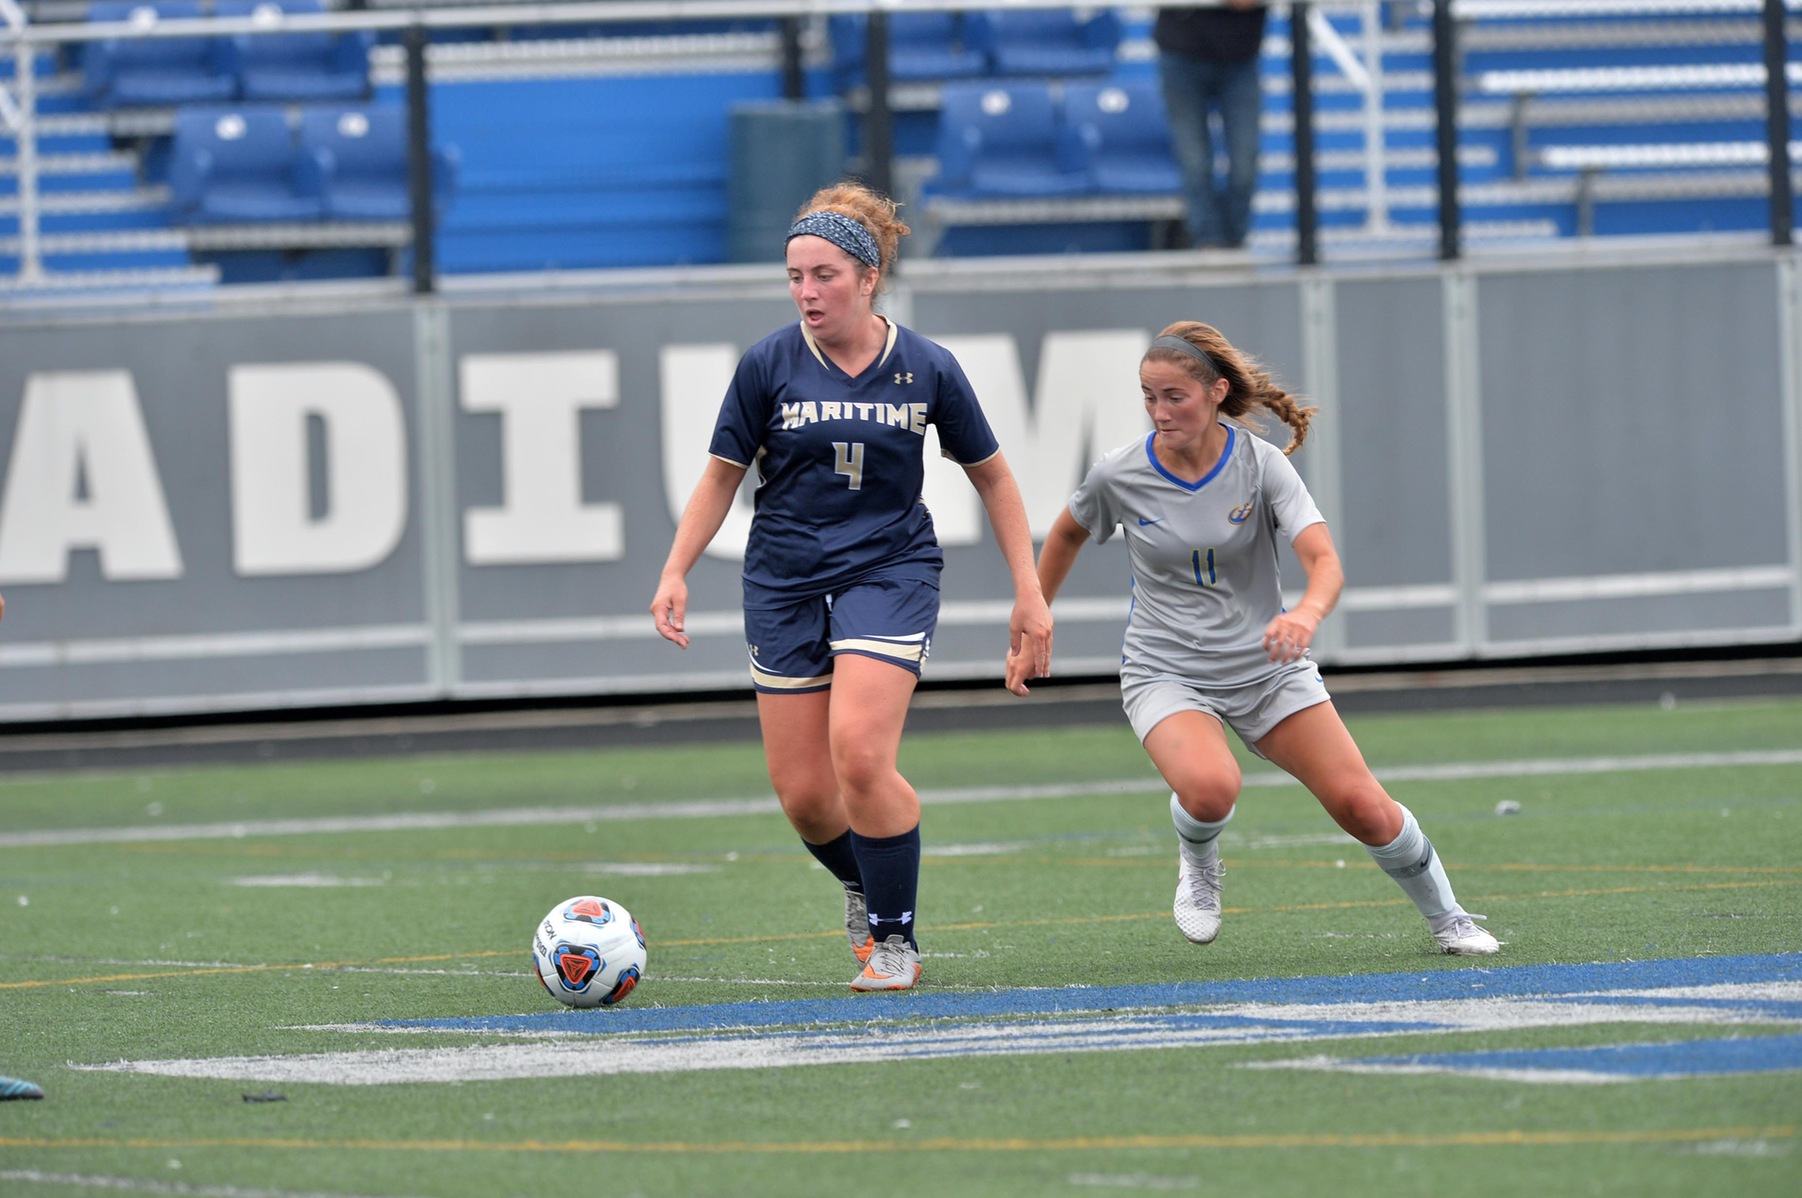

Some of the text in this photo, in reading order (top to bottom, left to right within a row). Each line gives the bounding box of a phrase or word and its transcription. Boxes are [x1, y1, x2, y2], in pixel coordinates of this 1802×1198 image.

[780, 401, 928, 436] MARITIME
[831, 442, 865, 491] 4
[1191, 547, 1217, 587] 11
